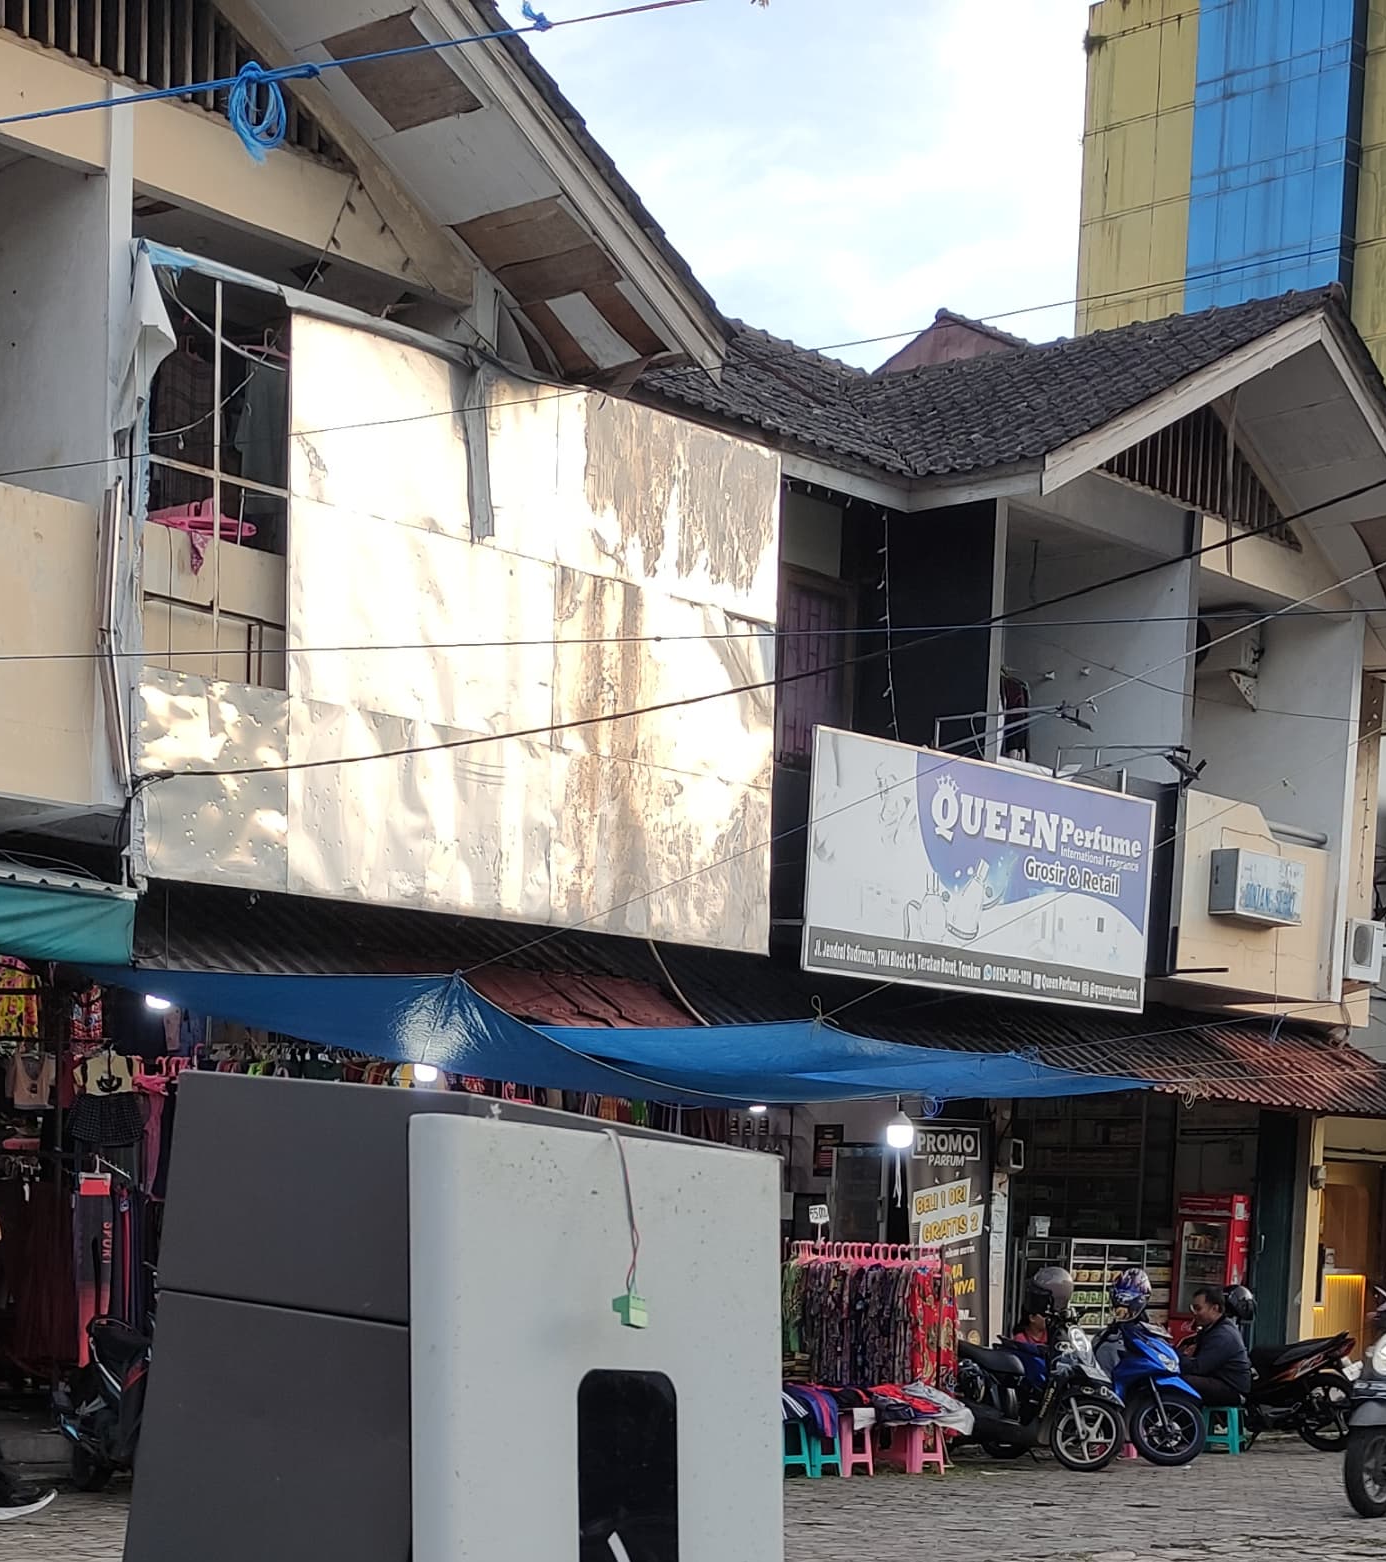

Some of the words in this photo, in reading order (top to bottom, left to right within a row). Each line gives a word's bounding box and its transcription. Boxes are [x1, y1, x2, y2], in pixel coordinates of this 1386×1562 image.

[931, 783, 1060, 852] QUEEN
[1061, 818, 1142, 857] Perfume
[1061, 846, 1104, 865] International
[1104, 855, 1139, 872] Fragrance
[1024, 856, 1065, 884] Grosir
[1068, 869, 1081, 887] &
[1082, 870, 1120, 897] Retail
[917, 1133, 975, 1153] PROMO
[928, 1154, 965, 1167] PARFUM
[916, 1192, 938, 1215] BELI
[949, 1186, 966, 1205] ORI
[922, 1215, 967, 1243] GRATIS
[970, 1214, 979, 1231] 2
